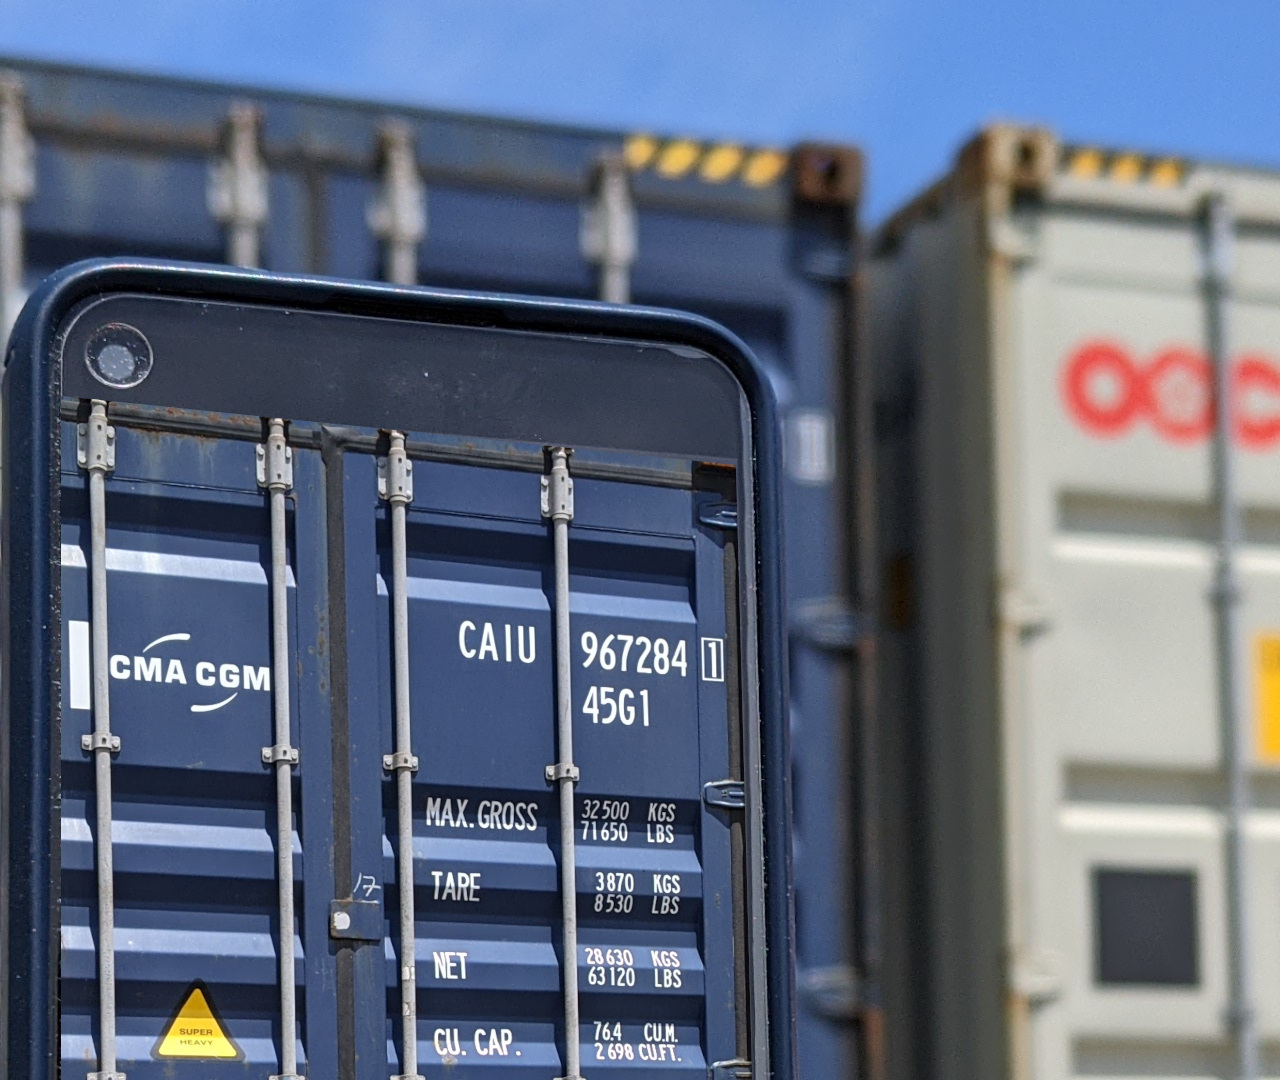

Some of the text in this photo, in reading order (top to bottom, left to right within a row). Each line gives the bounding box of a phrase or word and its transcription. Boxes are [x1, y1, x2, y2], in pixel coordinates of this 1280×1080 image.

[458, 620, 536, 663] CAIU
[581, 631, 688, 677] 967284
[109, 654, 271, 692] CMA CGM
[582, 685, 650, 727] 45G1
[477, 799, 539, 831] GROSS
[647, 802, 676, 822] KGS
[646, 824, 675, 843] LBS
[431, 871, 482, 902] TARE
[653, 874, 681, 894] KGS
[651, 896, 680, 915] LBS
[433, 951, 468, 980] NET
[651, 950, 681, 968] KGS
[654, 968, 682, 988] LBS
[179, 1028, 213, 1036] SUPER
[433, 1028, 467, 1056] CU.
[593, 1021, 622, 1041] 76.4
